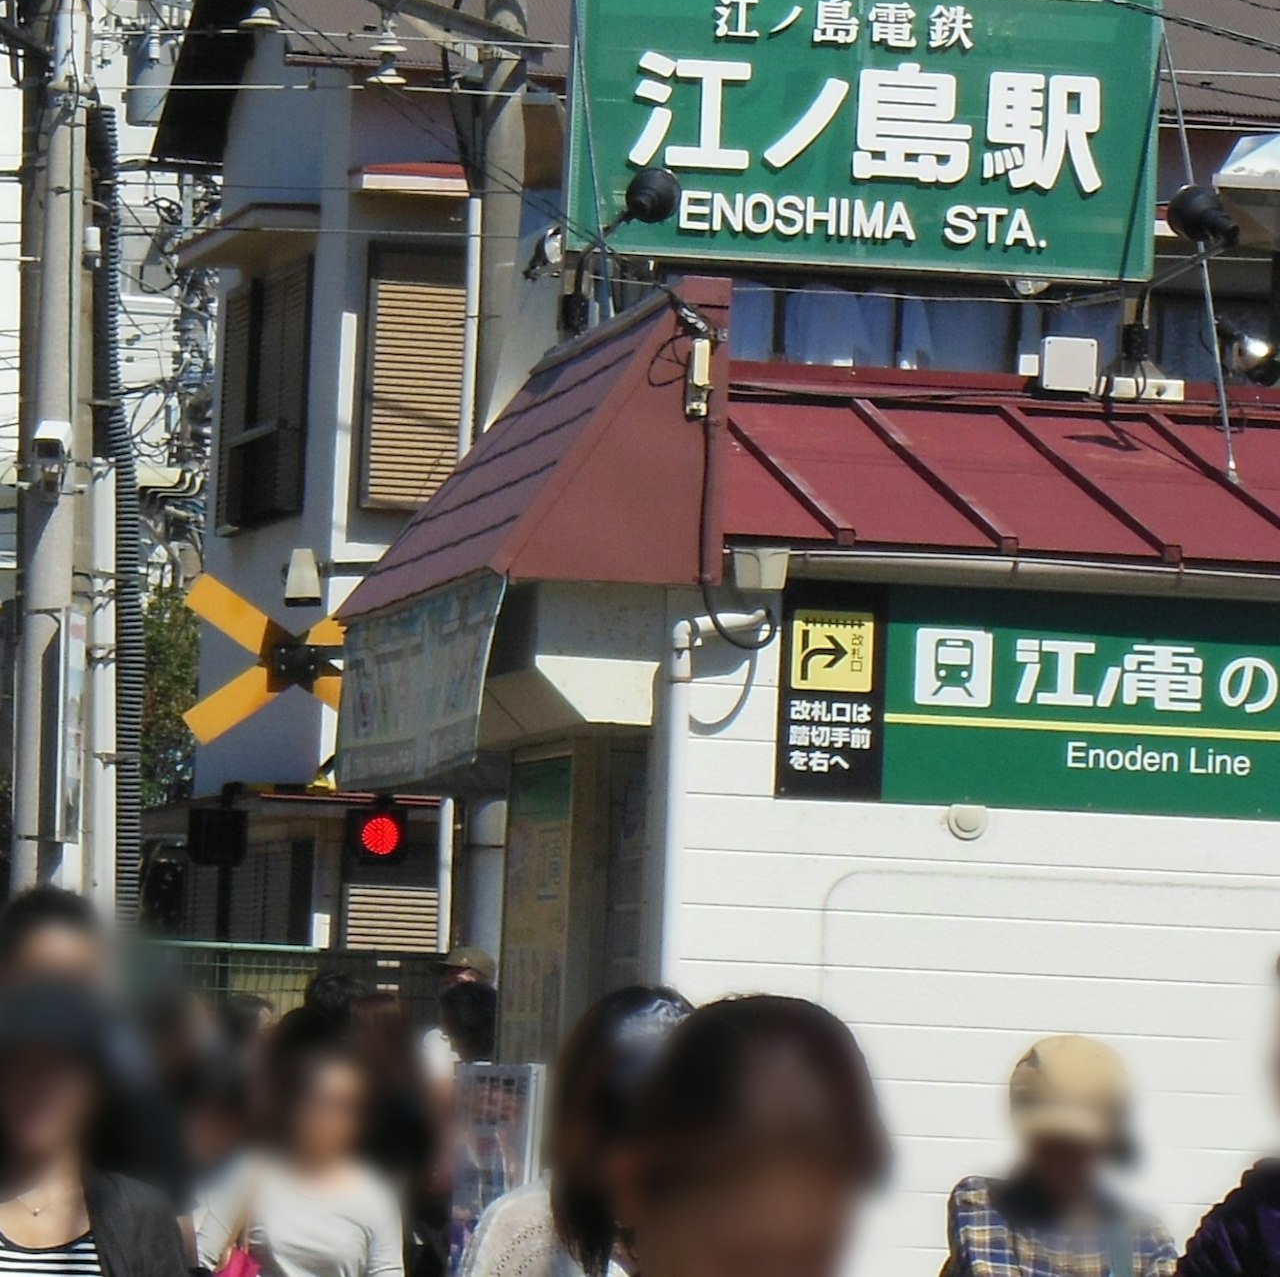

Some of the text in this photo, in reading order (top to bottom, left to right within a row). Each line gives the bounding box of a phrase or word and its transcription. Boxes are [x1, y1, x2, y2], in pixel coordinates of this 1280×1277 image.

[628, 51, 1102, 195] 江ノ島駅
[678, 189, 1048, 249] ENOSHIMA STA.
[850, 633, 864, 673] 改札口
[789, 699, 872, 723] 改札口は
[788, 725, 872, 750] 踏切手前
[789, 750, 850, 773] を右へ
[1066, 741, 1251, 777] Enoden Line
